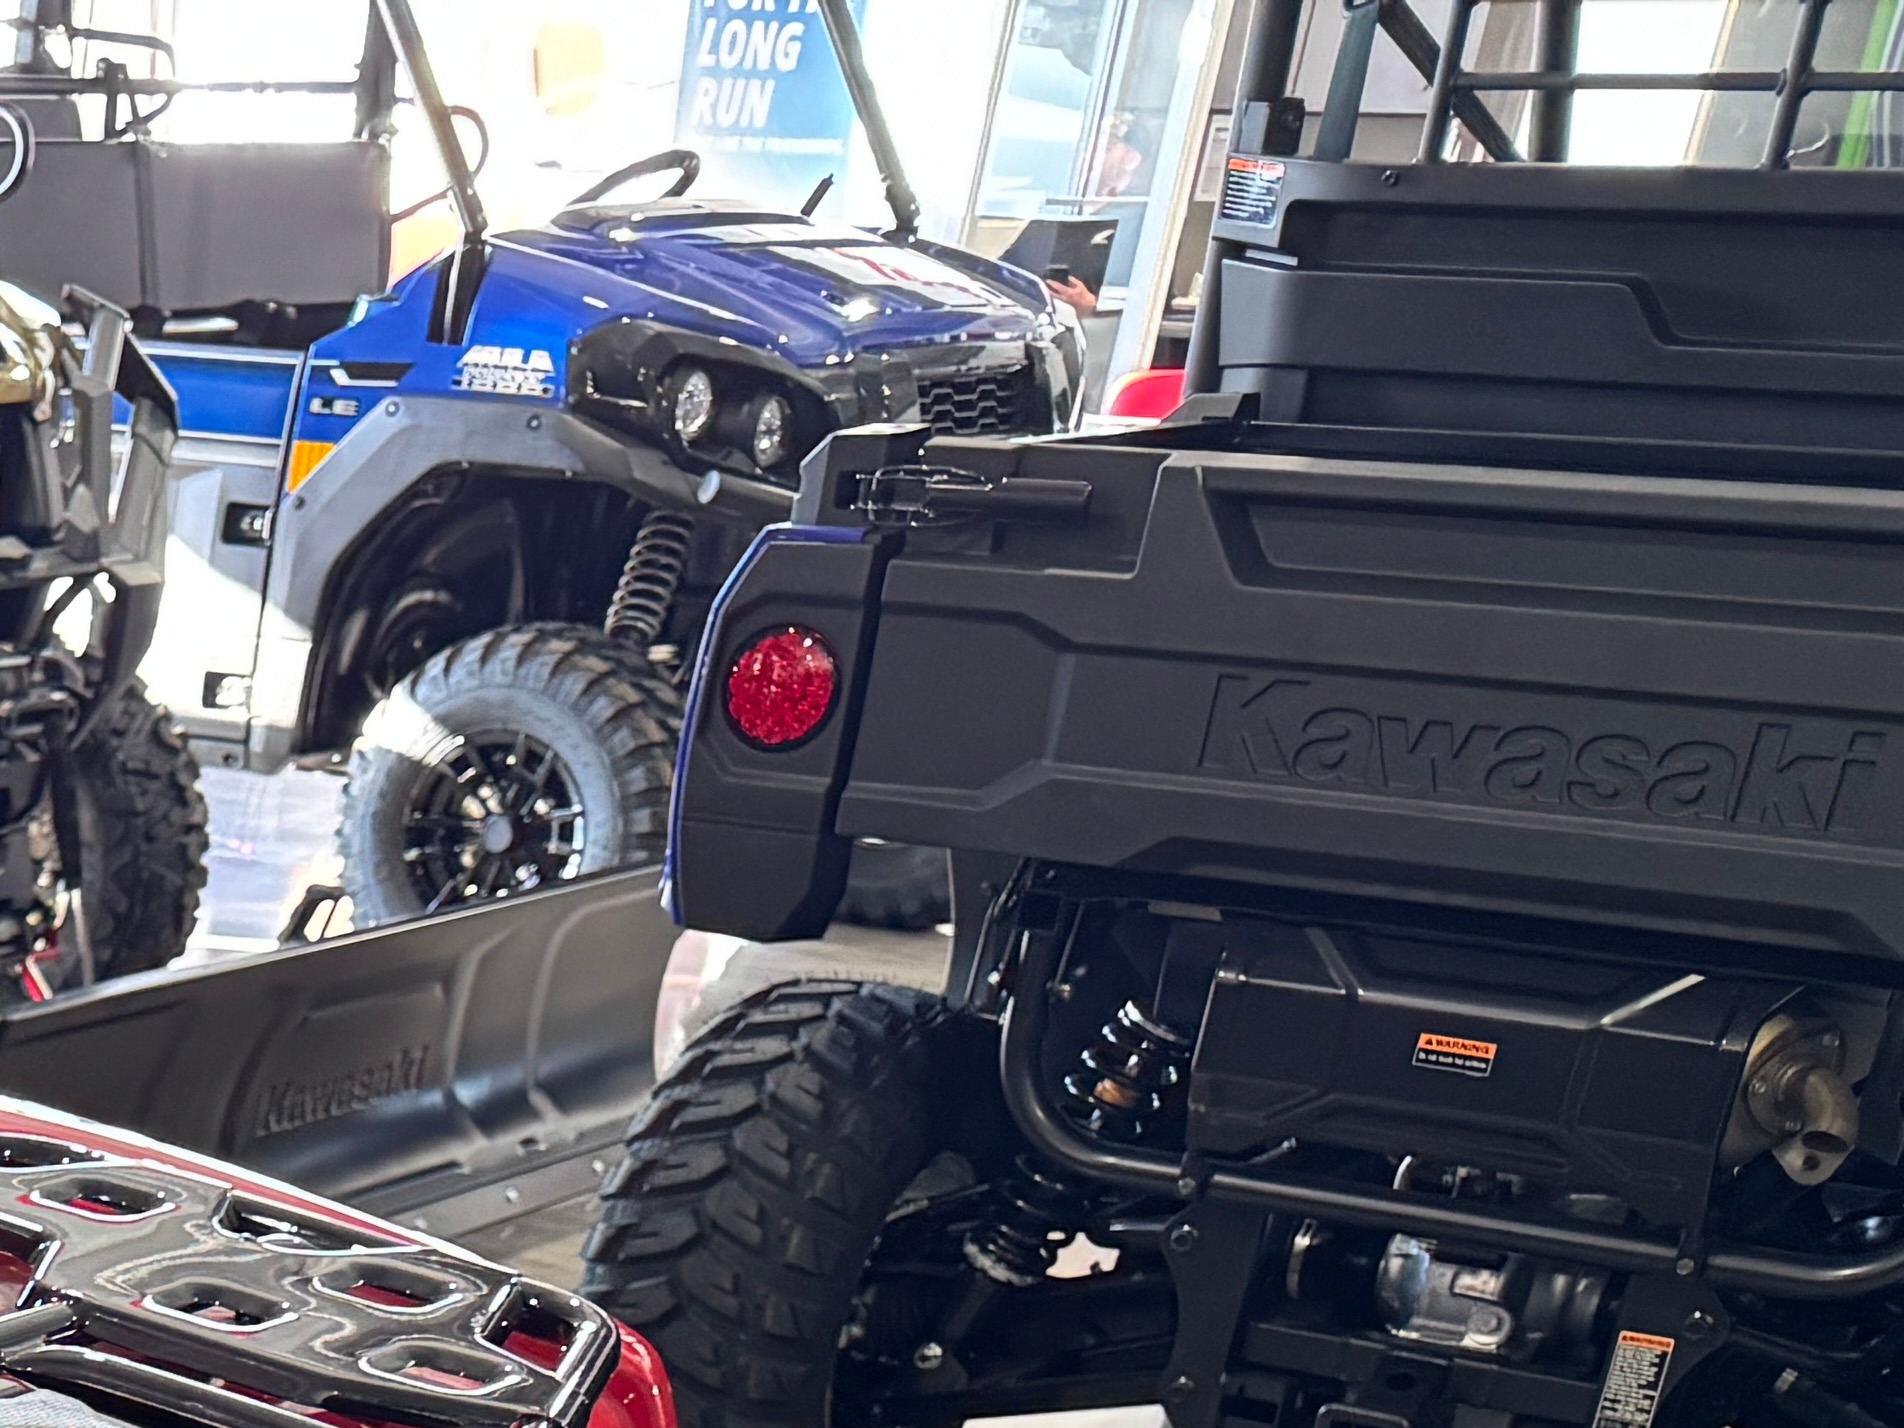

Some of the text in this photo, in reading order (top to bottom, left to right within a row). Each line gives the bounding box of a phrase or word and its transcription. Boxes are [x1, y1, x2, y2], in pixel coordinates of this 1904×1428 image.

[697, 17, 806, 73] LONG
[692, 75, 777, 129] RUN
[1197, 673, 1886, 833] Kawasaki
[254, 1044, 431, 1138] Kawasaki
